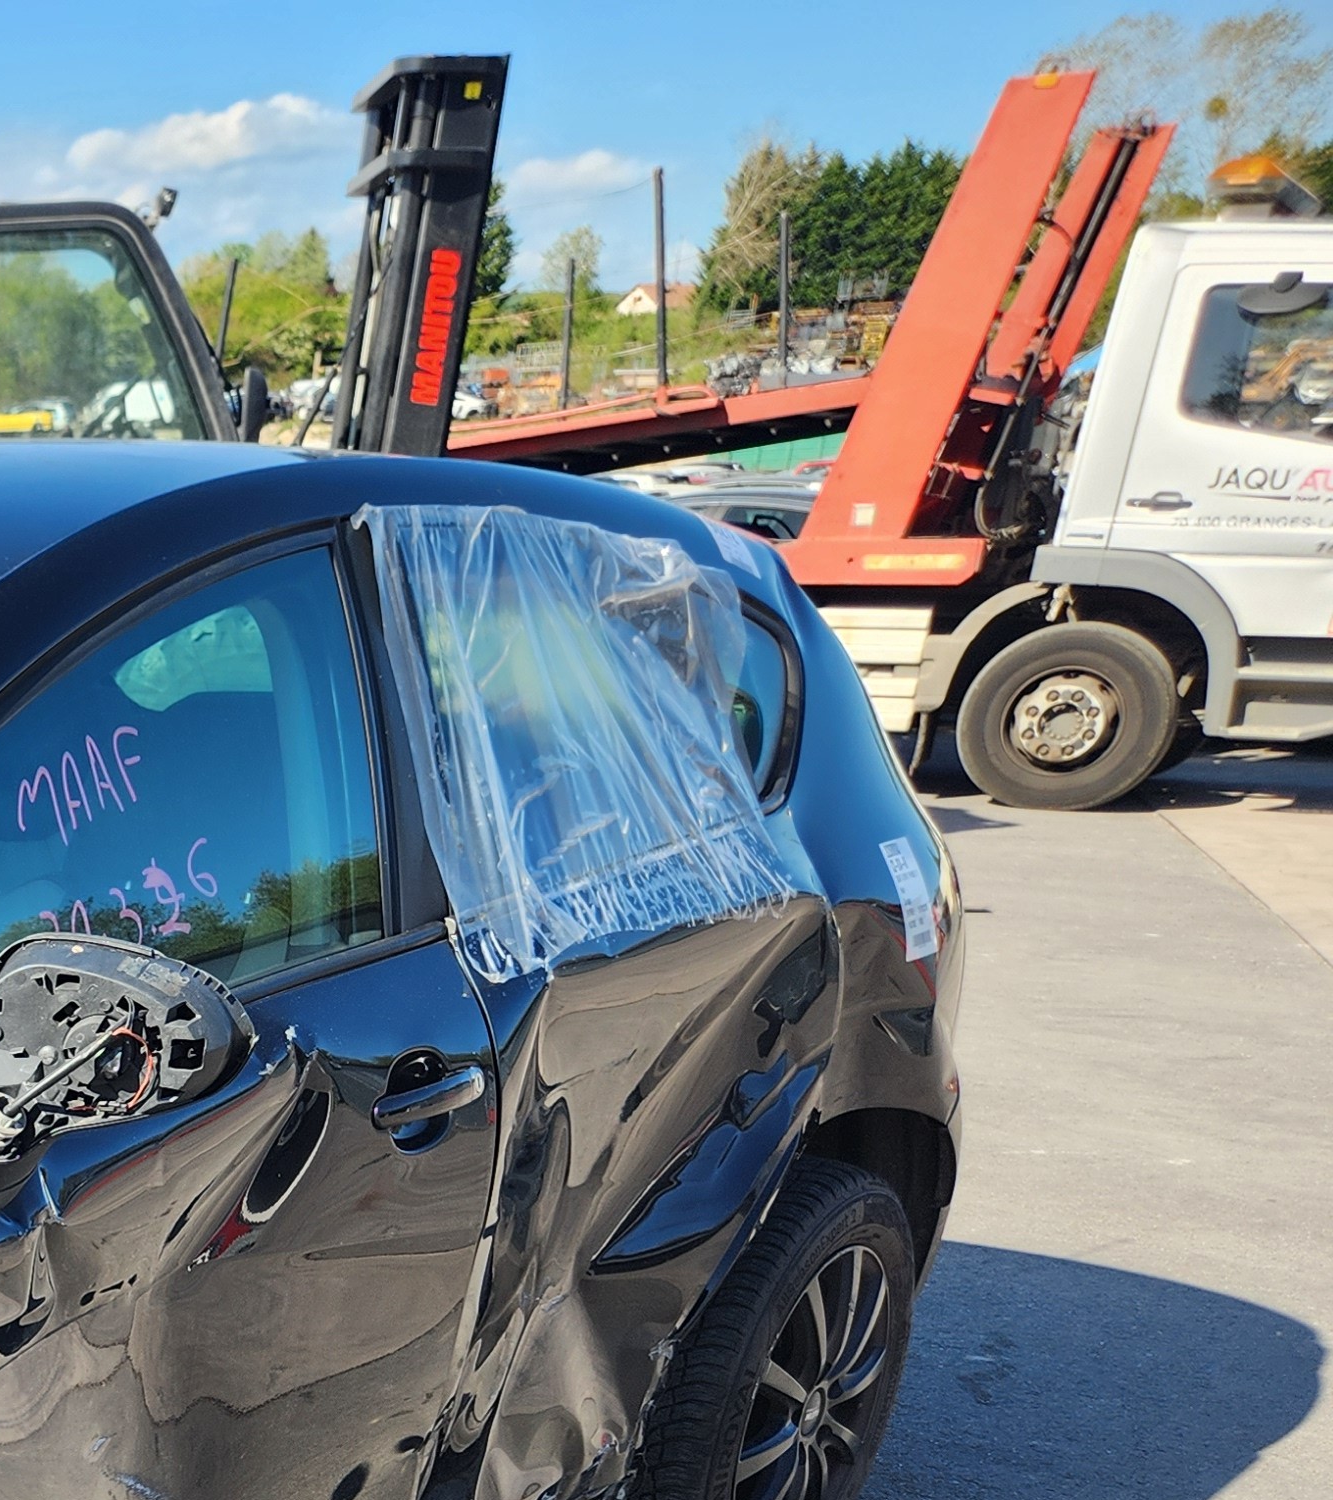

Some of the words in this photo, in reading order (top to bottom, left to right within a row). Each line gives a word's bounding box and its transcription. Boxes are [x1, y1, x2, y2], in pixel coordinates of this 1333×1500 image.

[410, 248, 462, 407] MANITOU
[1226, 515, 1333, 528] GRANGES-L
[17, 726, 141, 846] MAAF
